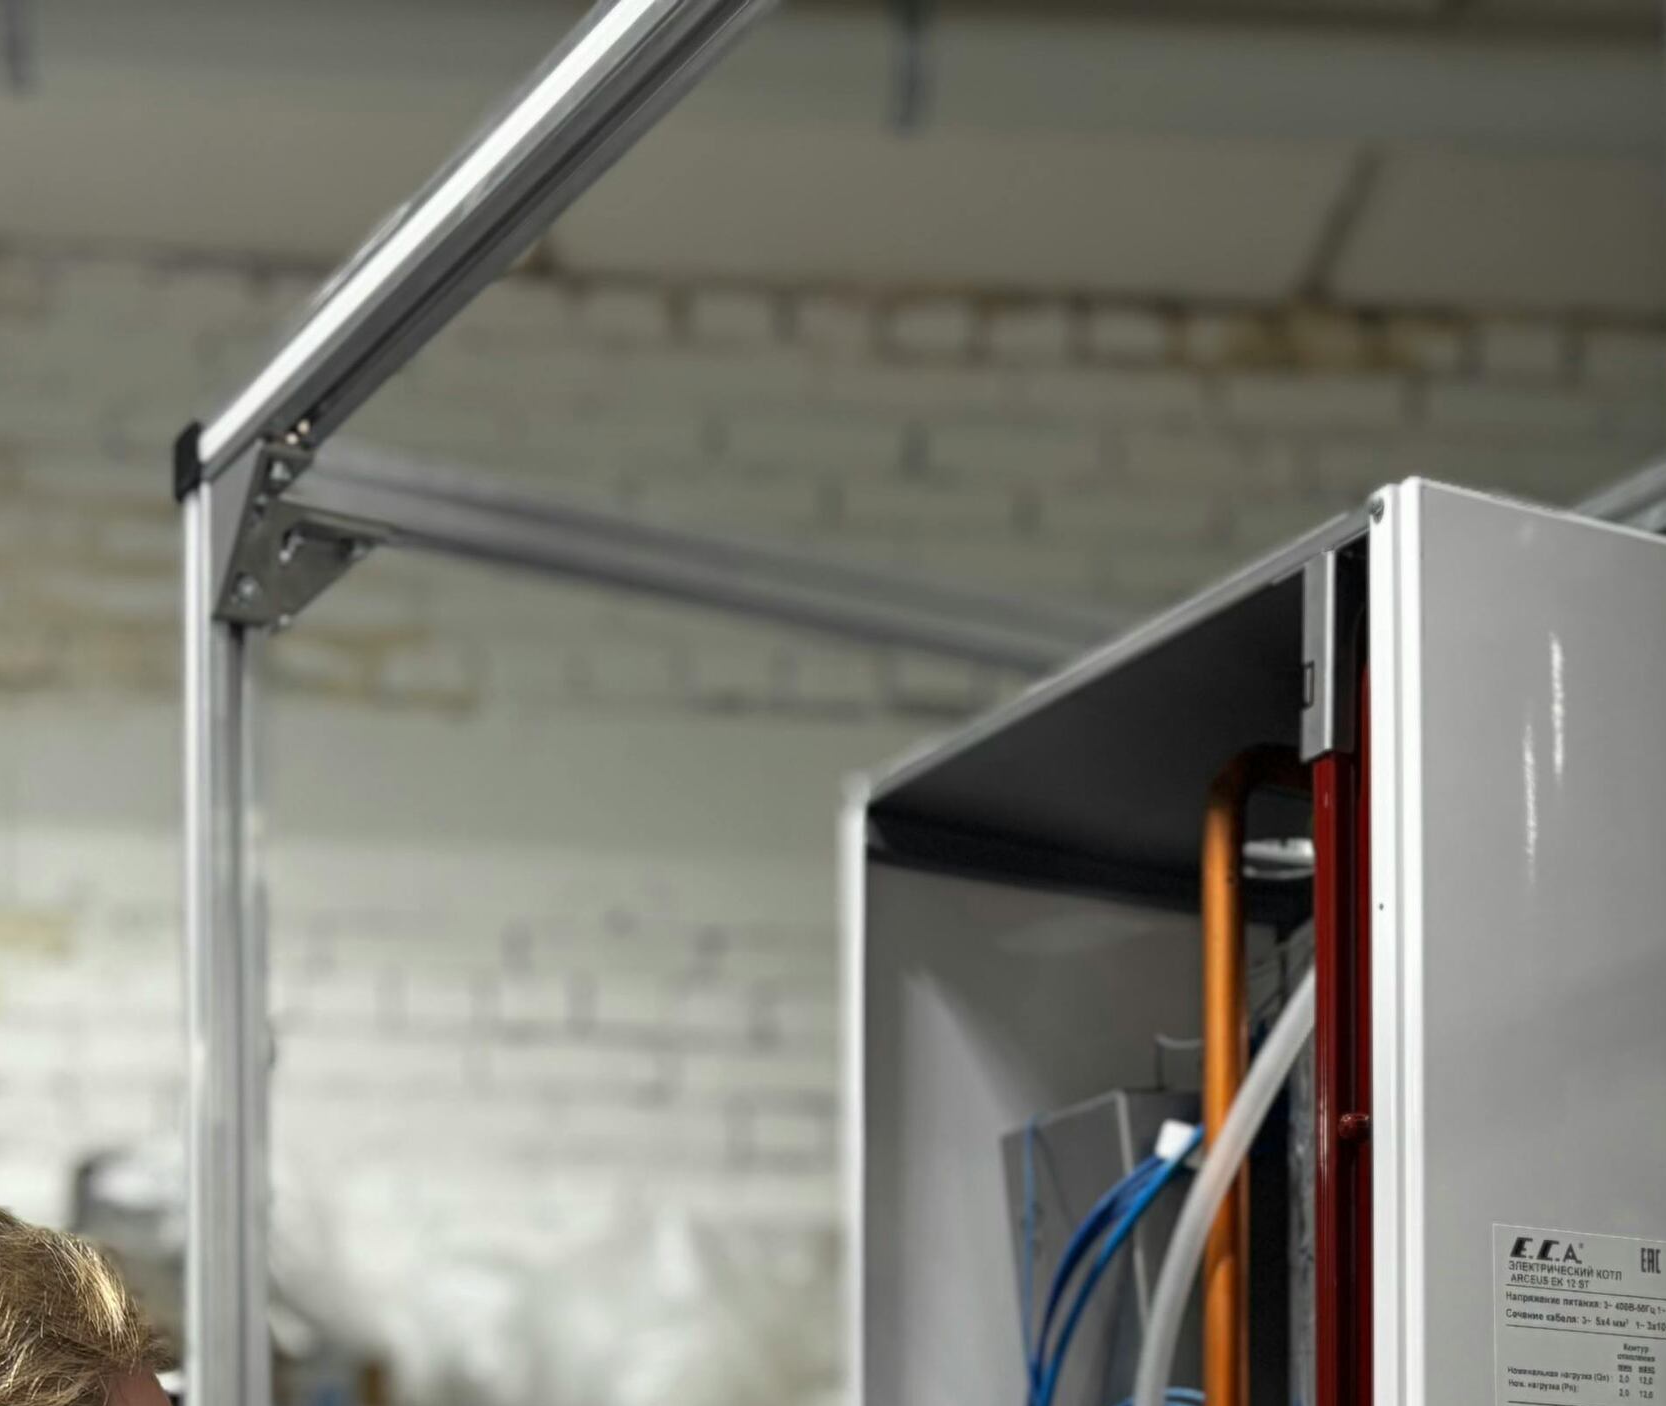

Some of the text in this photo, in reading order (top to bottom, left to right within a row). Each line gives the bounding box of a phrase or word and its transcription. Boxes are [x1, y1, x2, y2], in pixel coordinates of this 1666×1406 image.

[1640, 1247, 1662, 1274] EAC
[1508, 1261, 1623, 1281] ЭЛЕКТРИЧЕСКИЙ КОТЛ
[1510, 1273, 1549, 1286] ARCEUS
[1567, 1279, 1576, 1289] 12
